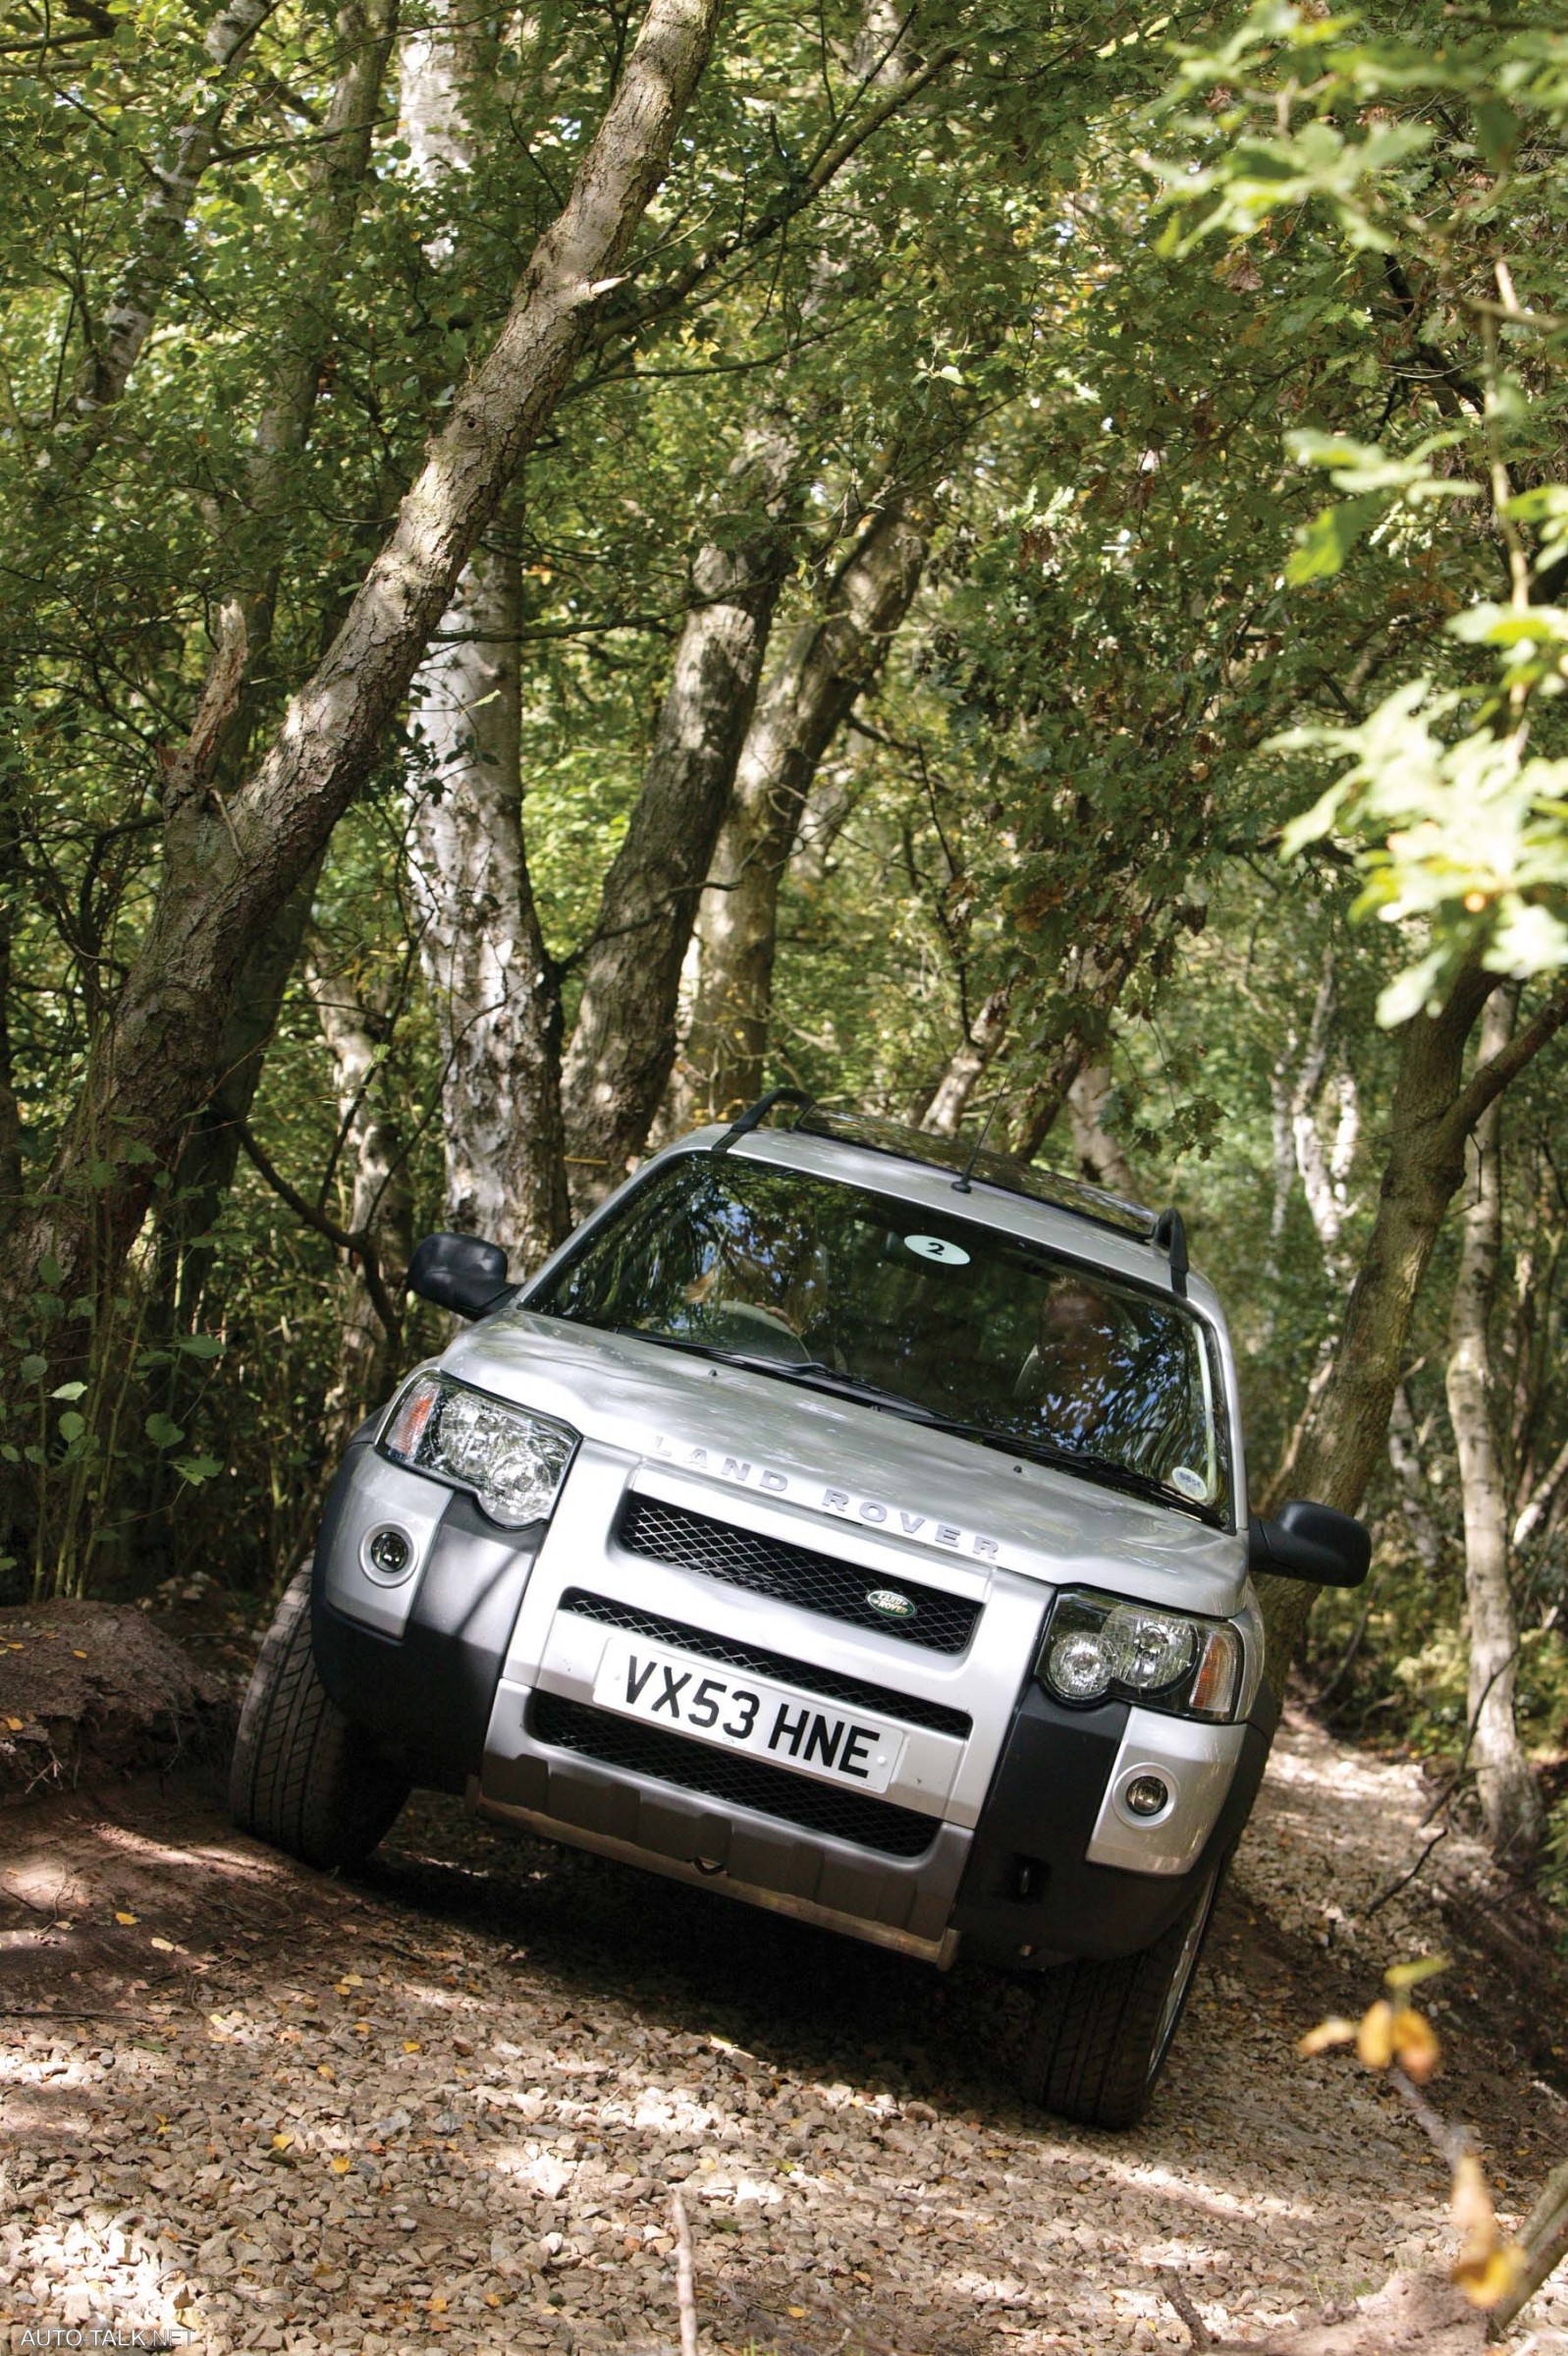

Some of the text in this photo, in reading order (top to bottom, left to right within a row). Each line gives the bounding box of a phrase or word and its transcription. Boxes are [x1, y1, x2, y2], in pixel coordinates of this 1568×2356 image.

[926, 1242, 946, 1256] 2
[654, 1436, 1000, 1560] LAND ROVER
[878, 1600, 908, 1615] ROVER
[625, 1654, 881, 1779] VX53 HNE
